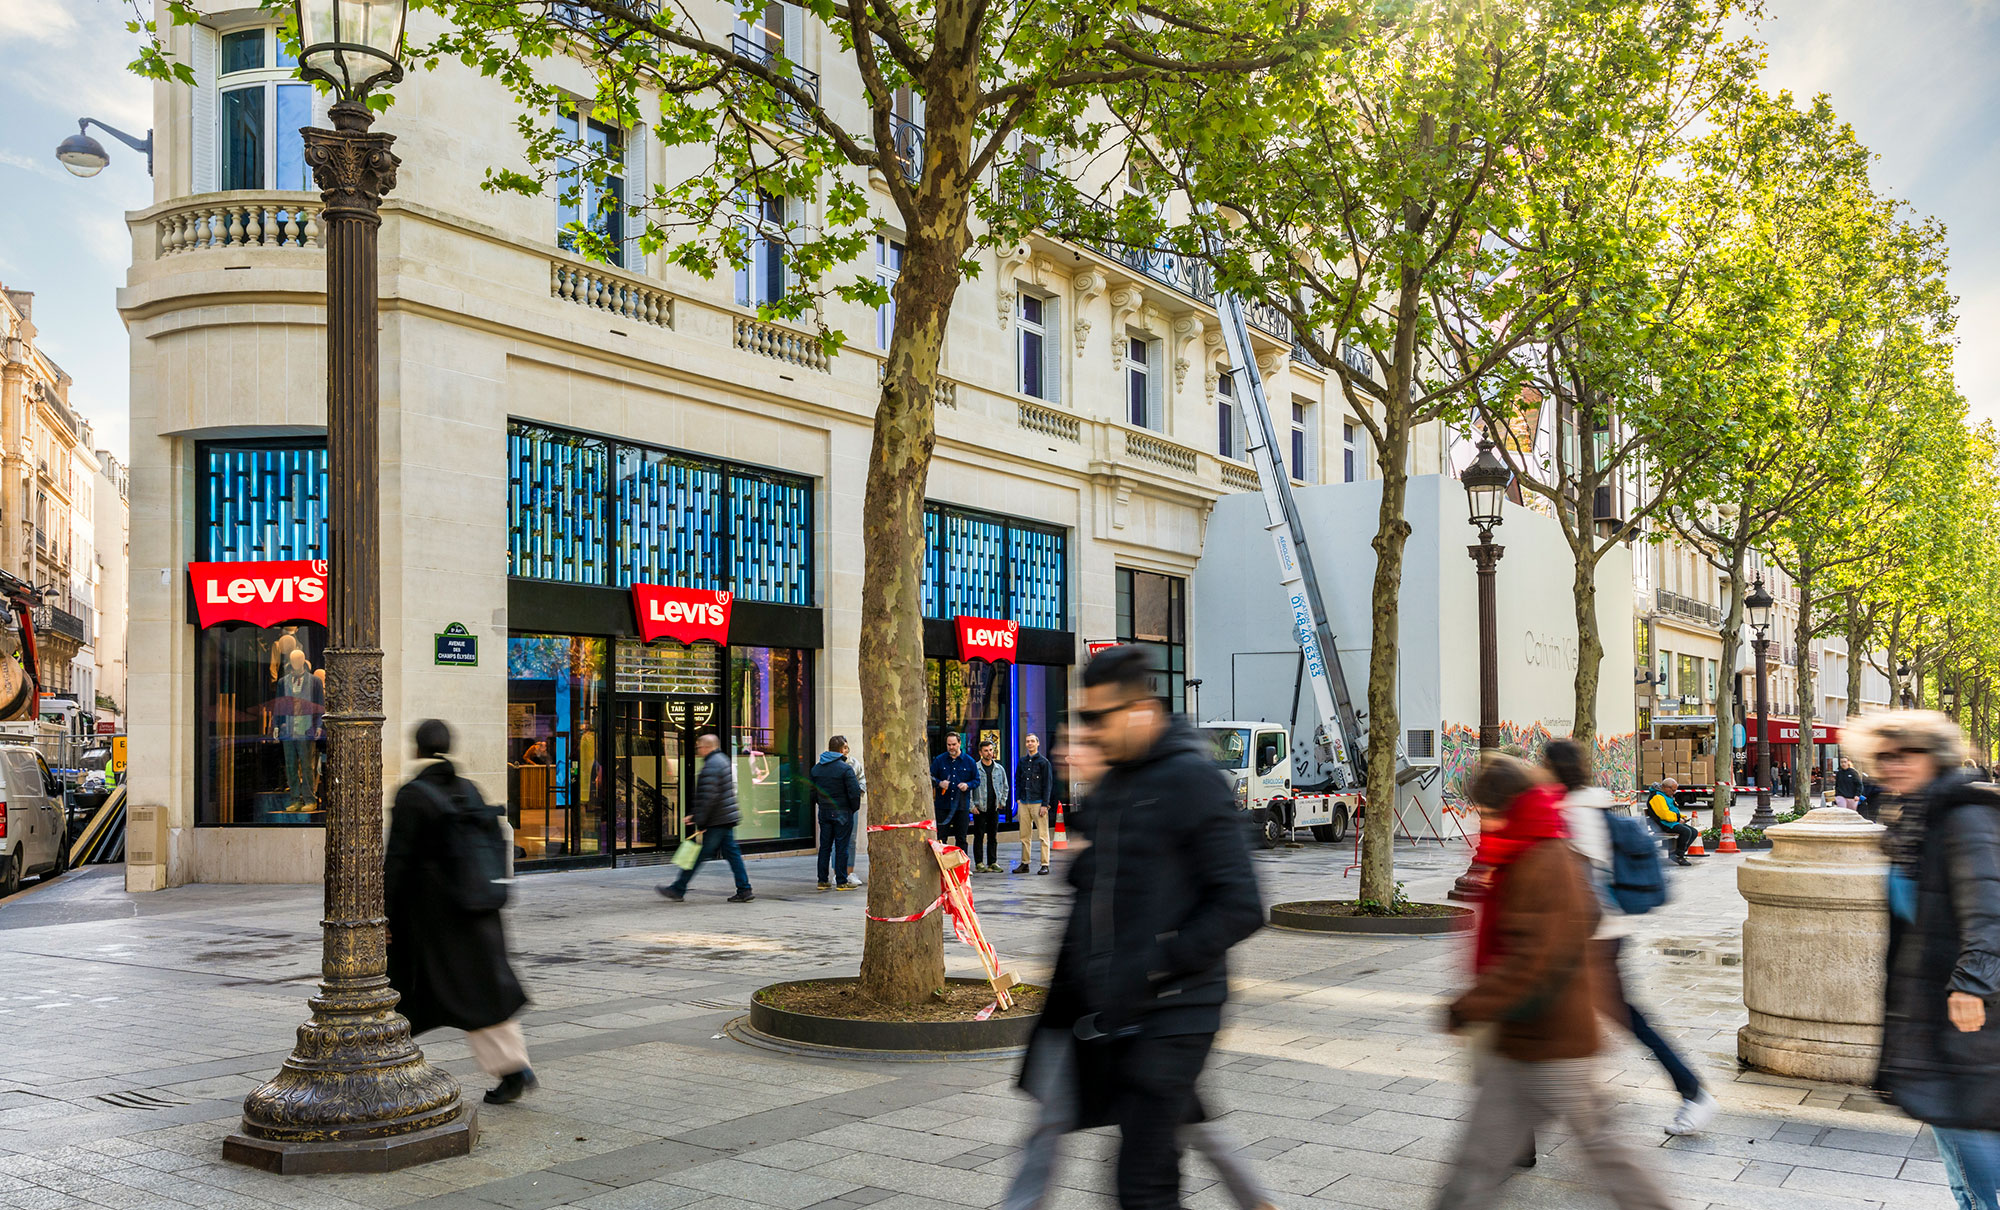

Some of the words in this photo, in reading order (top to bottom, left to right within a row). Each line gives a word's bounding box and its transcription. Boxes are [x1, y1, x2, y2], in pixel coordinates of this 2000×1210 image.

[1291, 595, 1302, 609] 01
[1298, 592, 1311, 624] LOCATION
[1296, 612, 1307, 626] 48
[1301, 628, 1311, 643] 40
[438, 652, 456, 660] CHAMPS
[1305, 645, 1316, 660] 63
[1525, 630, 1561, 670] Calvin
[1310, 662, 1321, 678] 63
